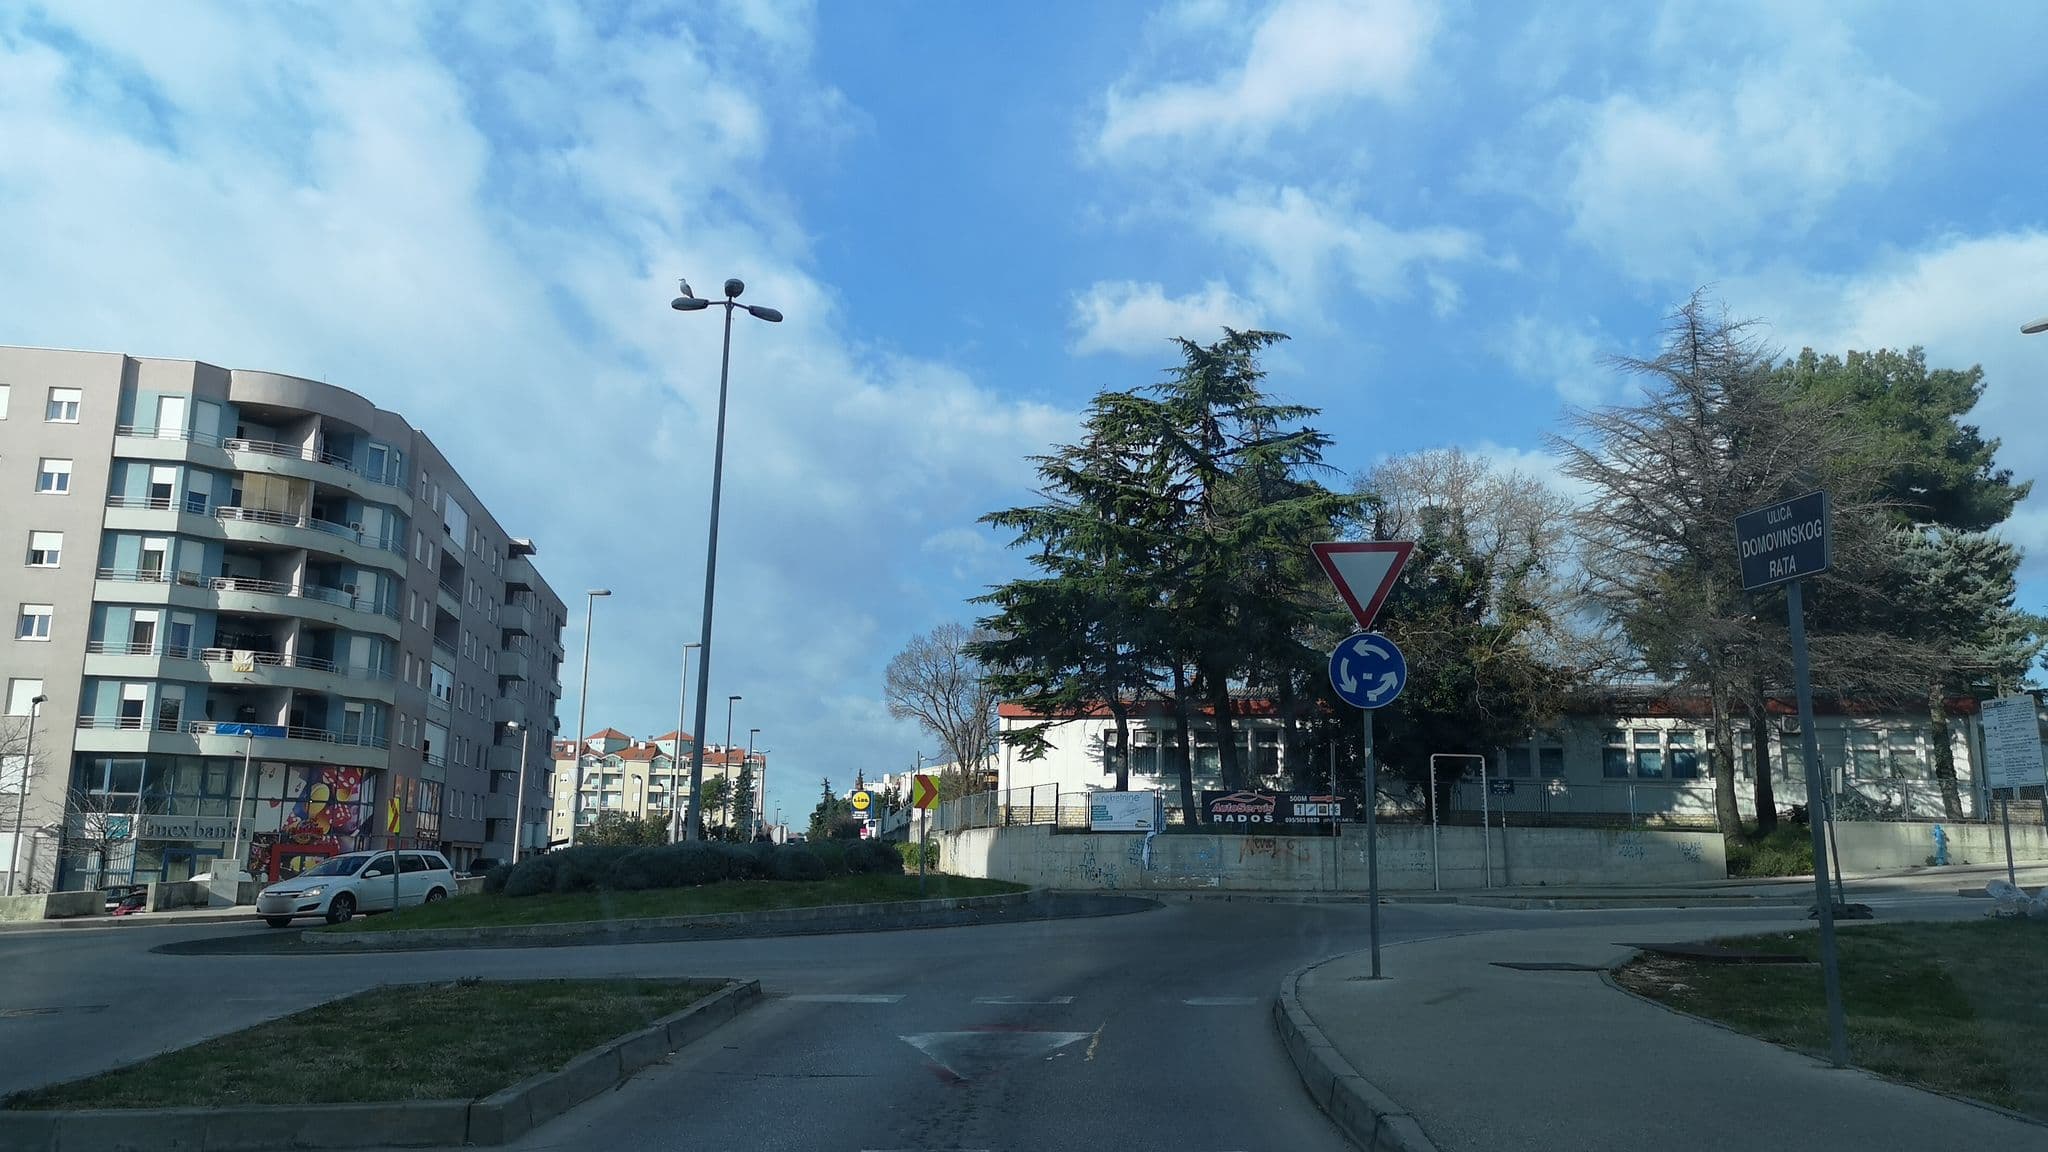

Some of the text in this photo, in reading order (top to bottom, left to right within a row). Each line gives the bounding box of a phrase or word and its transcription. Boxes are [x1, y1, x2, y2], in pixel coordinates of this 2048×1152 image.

[1767, 505, 1793, 524] ULICA
[1742, 518, 1822, 558] DOMOVINSKOG
[1769, 555, 1797, 578] RATA
